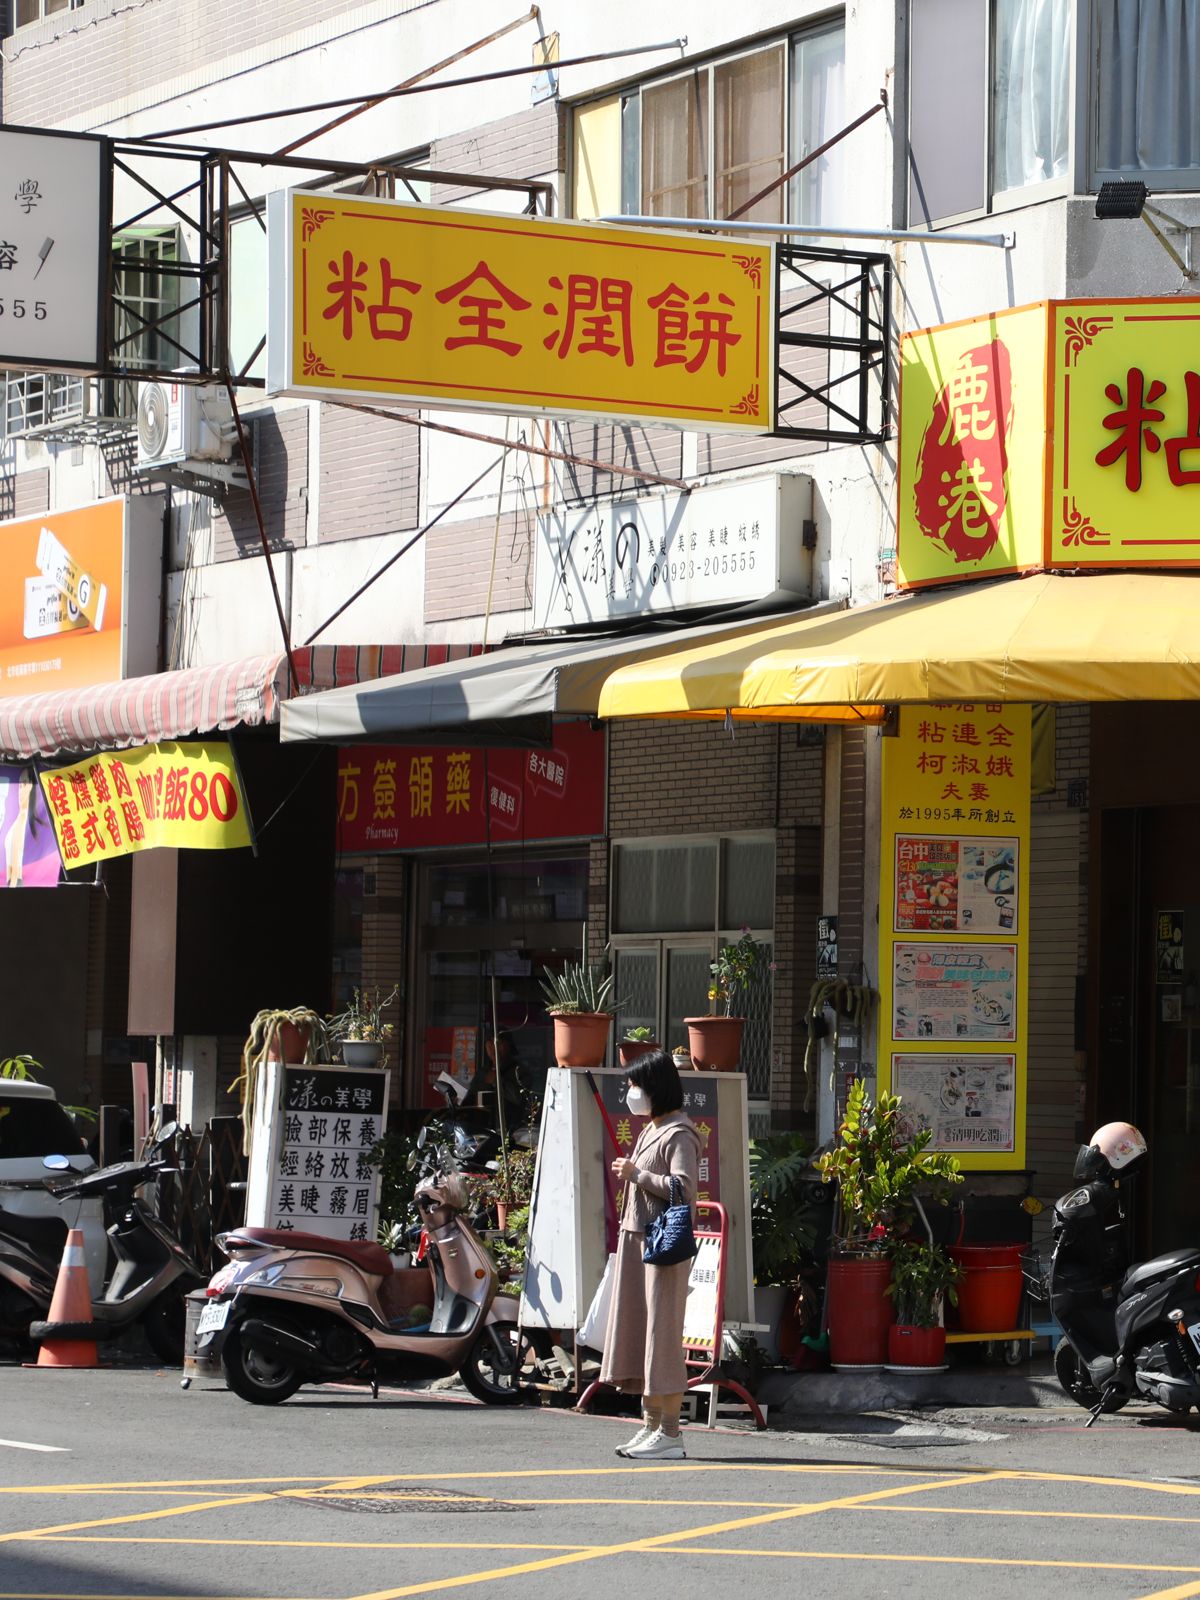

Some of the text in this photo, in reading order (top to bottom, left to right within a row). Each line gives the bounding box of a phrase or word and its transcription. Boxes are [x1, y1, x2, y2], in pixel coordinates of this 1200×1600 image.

[0, 299, 48, 320] 55
[322, 250, 742, 377] 粘全潤餅
[938, 352, 999, 539] 鹿港
[661, 550, 757, 584] 0923-205555
[917, 720, 1015, 748] 粘連全
[529, 752, 565, 787] 各大醫院
[916, 751, 1015, 778] 柯淑娥
[941, 782, 990, 801] 夫妻
[898, 806, 1016, 824] 於1995年所創立
[365, 823, 399, 844] Pharmacy
[899, 842, 929, 860] 台中
[285, 1113, 377, 1147] 臉部保養
[278, 1183, 370, 1216] 美睫霧眉
